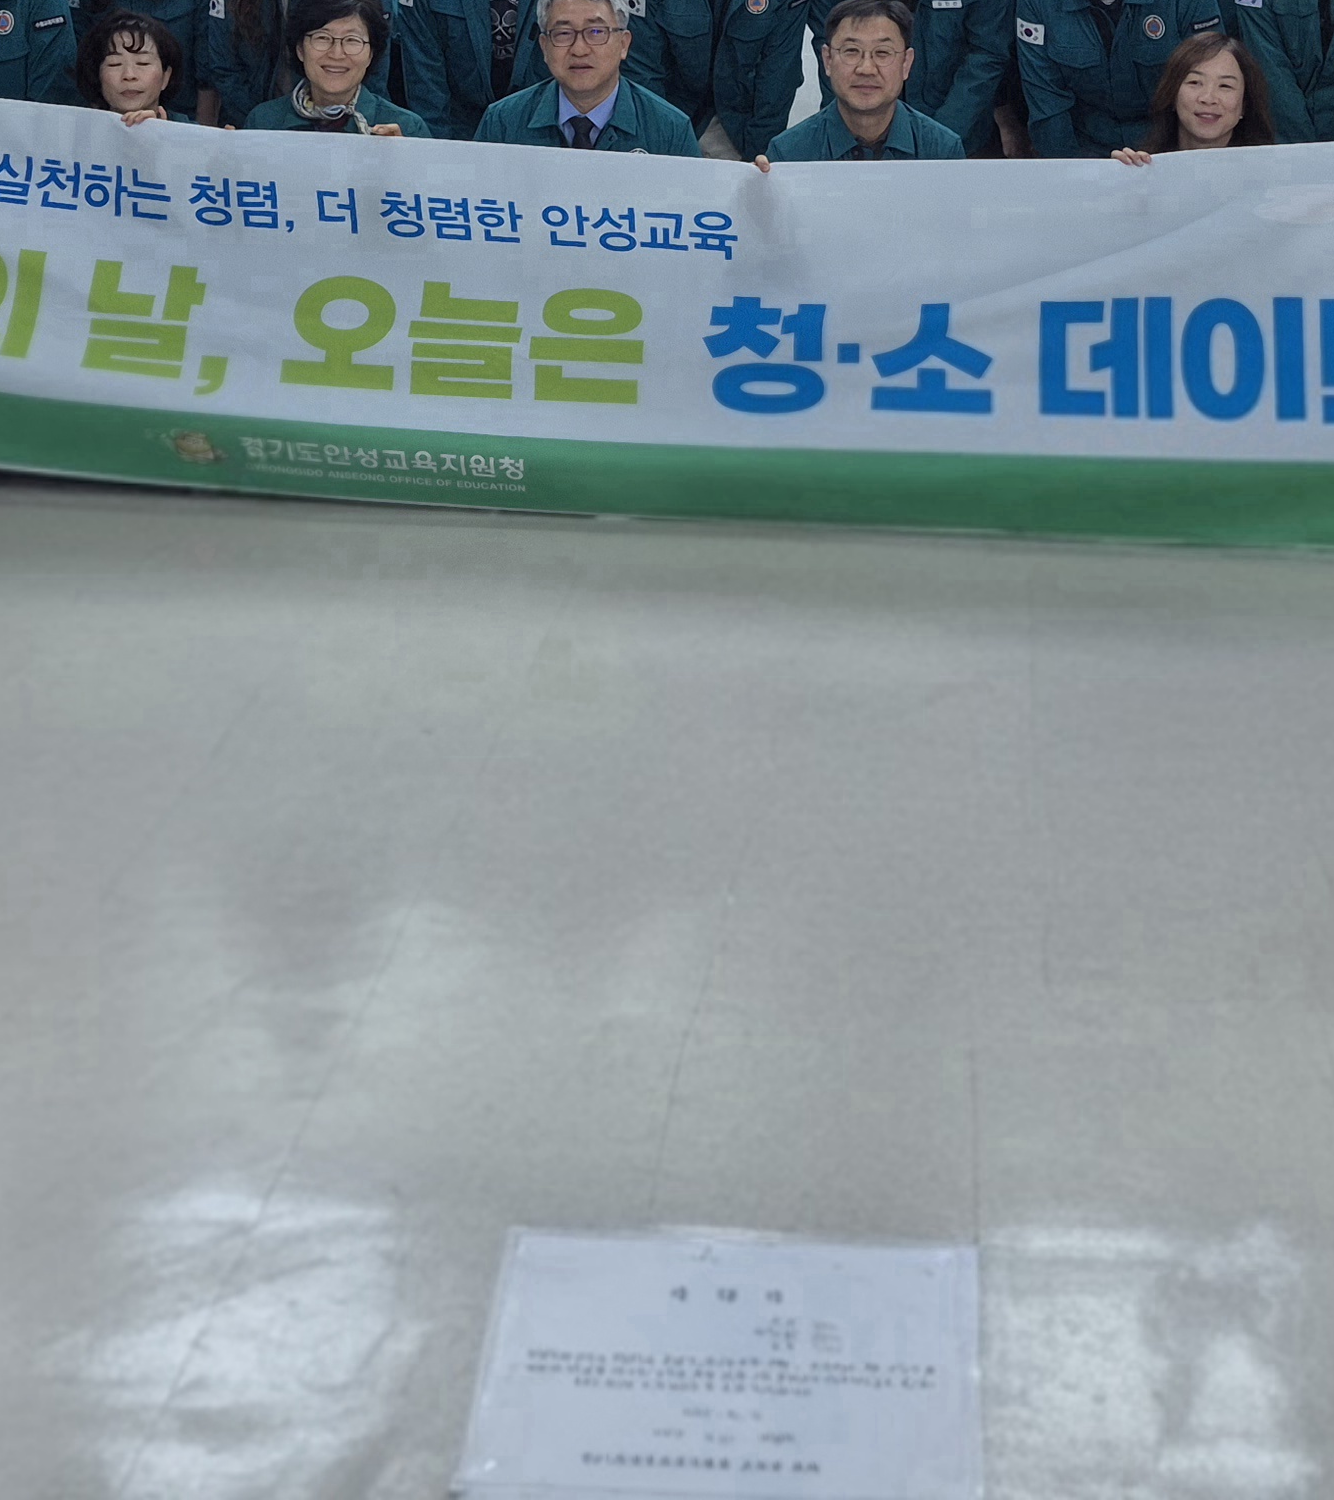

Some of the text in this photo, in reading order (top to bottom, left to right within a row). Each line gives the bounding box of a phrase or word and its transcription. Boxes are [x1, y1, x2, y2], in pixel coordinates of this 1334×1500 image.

[187, 174, 295, 234] 청렴,
[315, 186, 359, 235] 더
[378, 190, 523, 245] 청렴한
[540, 204, 739, 261] 안성교육
[80, 258, 229, 396] 날,
[279, 274, 645, 405] 오늘은
[703, 296, 994, 414] 청·소
[238, 435, 526, 481] 경기도안성교육지원청
[328, 470, 386, 483] ANSEONG
[389, 474, 433, 487] OFFICE
[436, 478, 453, 488] OF
[456, 479, 527, 493] EDUCATION
